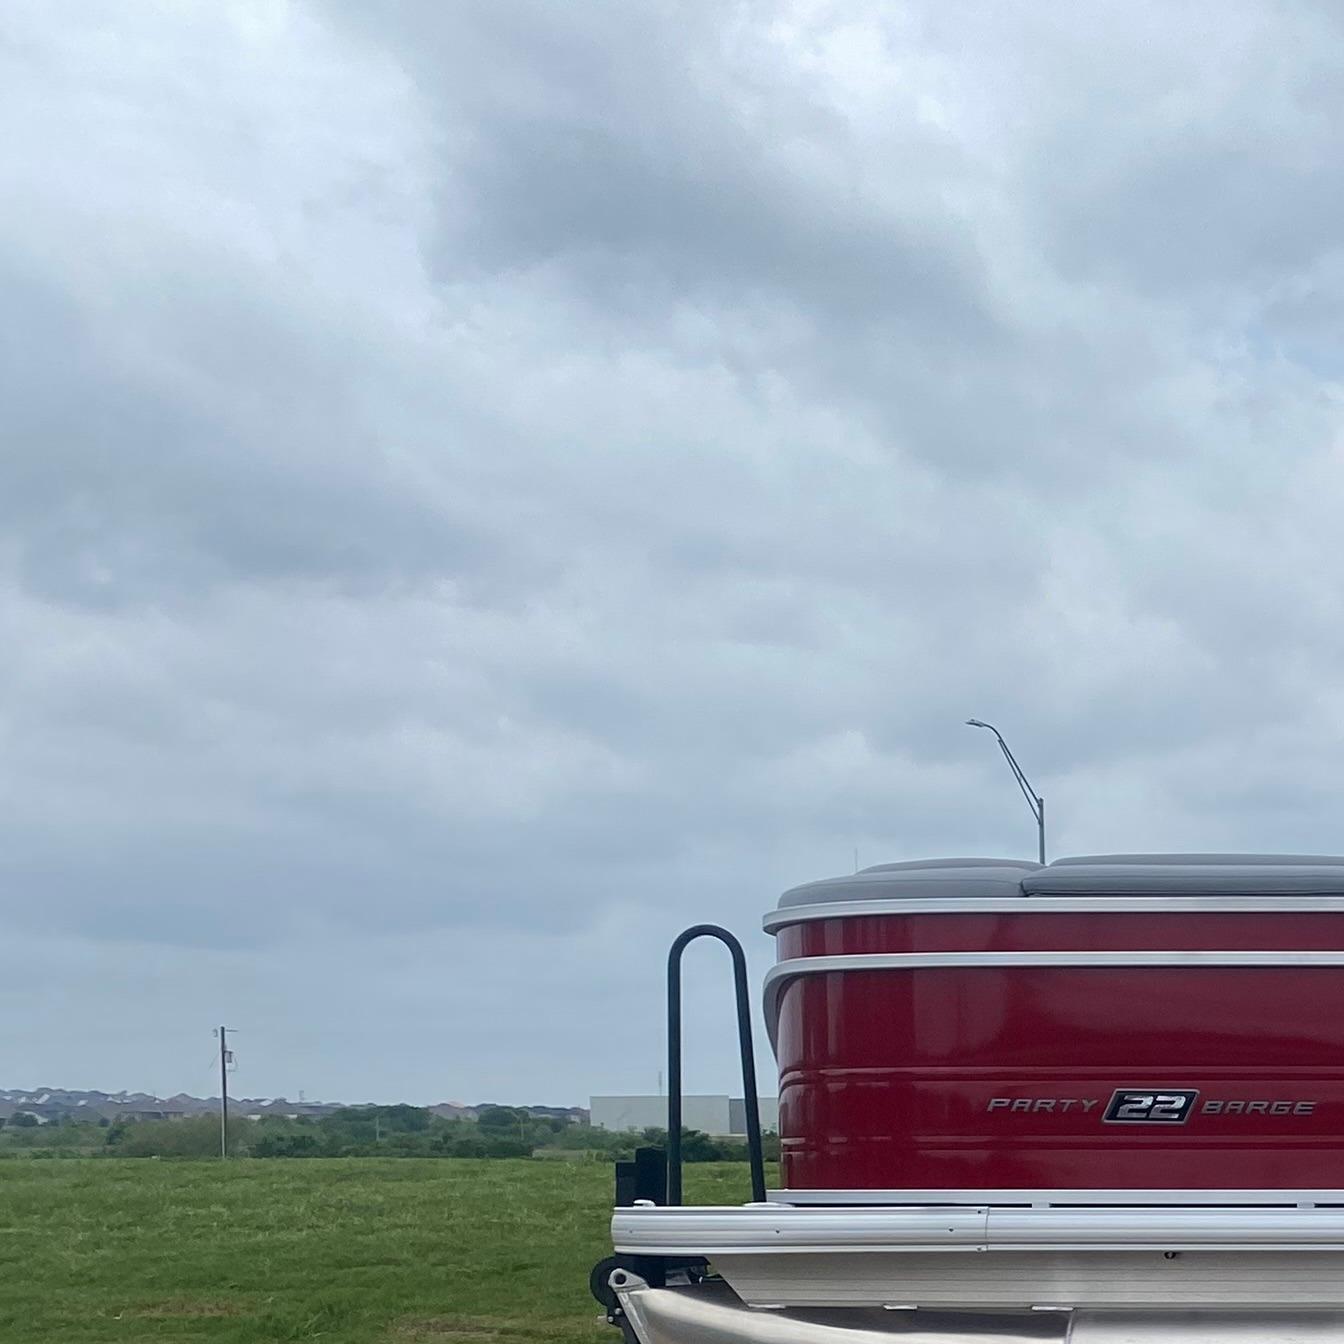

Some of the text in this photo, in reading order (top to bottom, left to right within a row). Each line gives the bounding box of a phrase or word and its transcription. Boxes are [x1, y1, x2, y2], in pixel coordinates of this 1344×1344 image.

[987, 1094, 1317, 1119] PARTY 22 BARGE
